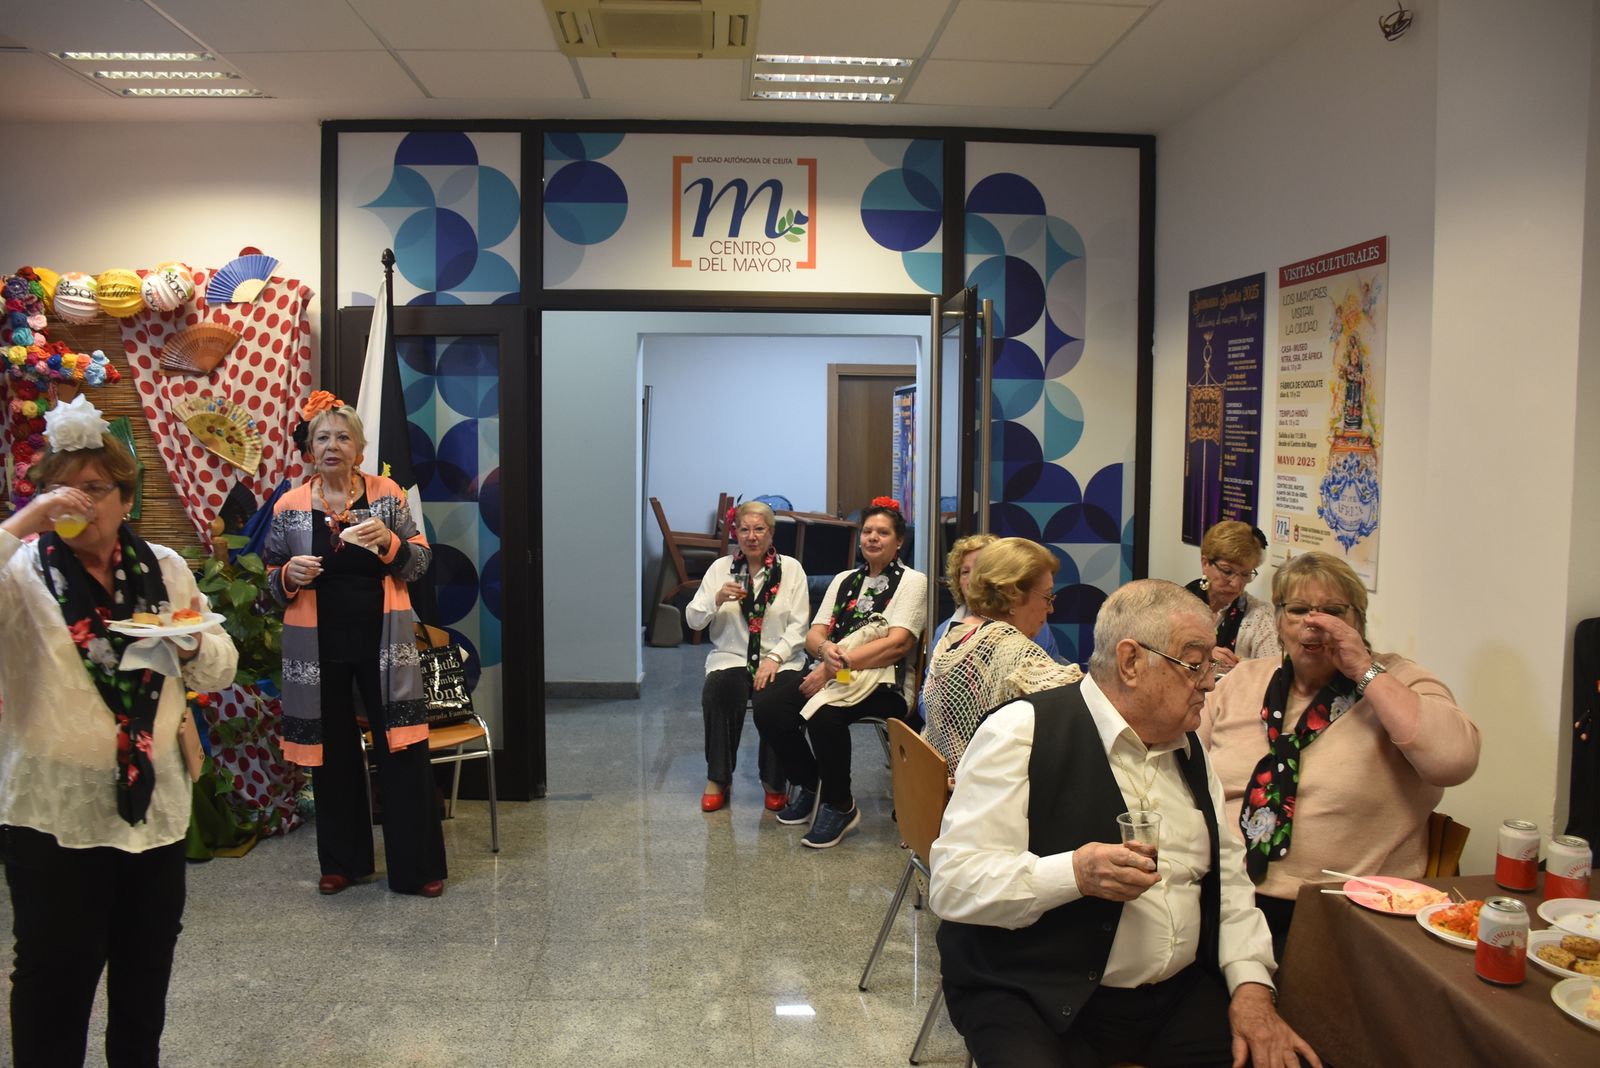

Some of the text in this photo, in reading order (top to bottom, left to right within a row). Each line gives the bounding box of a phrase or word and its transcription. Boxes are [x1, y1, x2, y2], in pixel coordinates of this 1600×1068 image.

[697, 154, 793, 165] CIUDAD AUTÓNOMA DE CEUTA
[710, 240, 776, 256] CENTRO
[699, 257, 791, 273] DEL MAYOR
[1283, 245, 1380, 281] VISITAS CULTURALES
[1283, 286, 1328, 306] LOS MAYORES
[1291, 305, 1314, 319] VISITAN
[1285, 319, 1318, 335] LA CIUDAD
[1277, 455, 1316, 467] MAYO 2025
[1490, 930, 1515, 946] ESTRELLA
